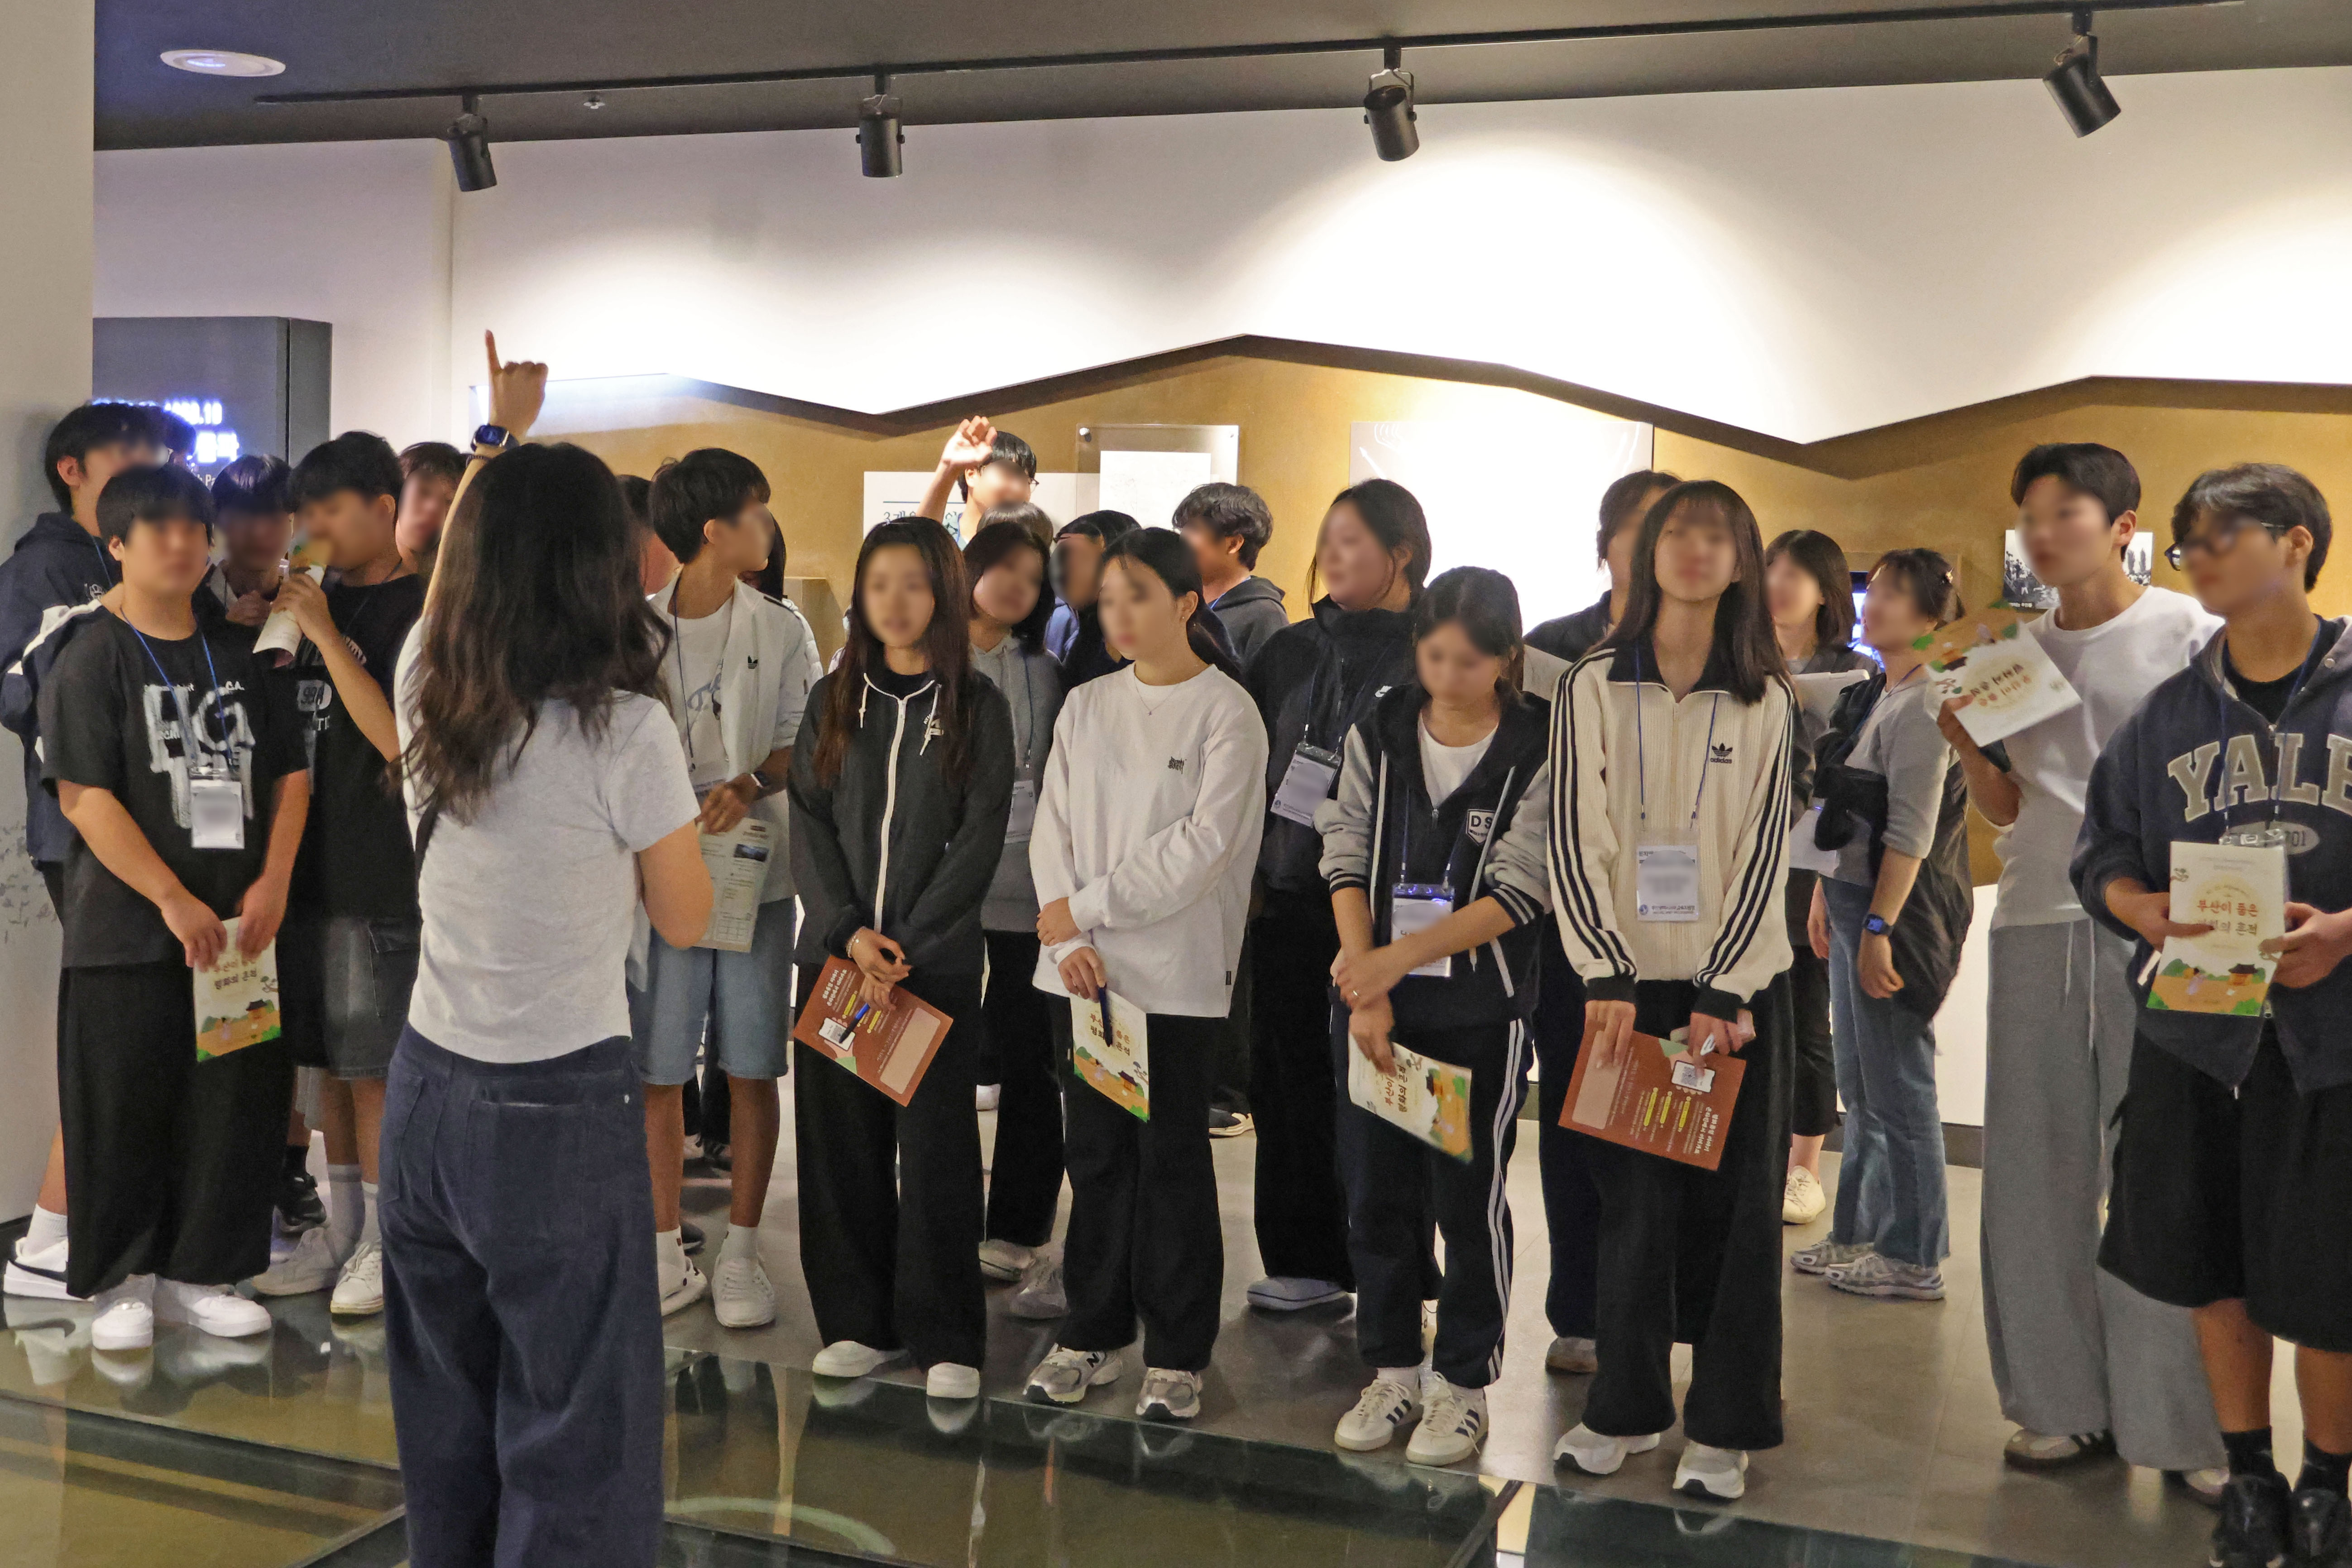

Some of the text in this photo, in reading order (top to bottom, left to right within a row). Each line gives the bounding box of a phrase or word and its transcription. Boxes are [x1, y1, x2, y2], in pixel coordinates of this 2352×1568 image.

[2167, 733, 2352, 823] YALE
[2197, 900, 2232, 914] 부산이
[1384, 1077, 1394, 1106] 부산이
